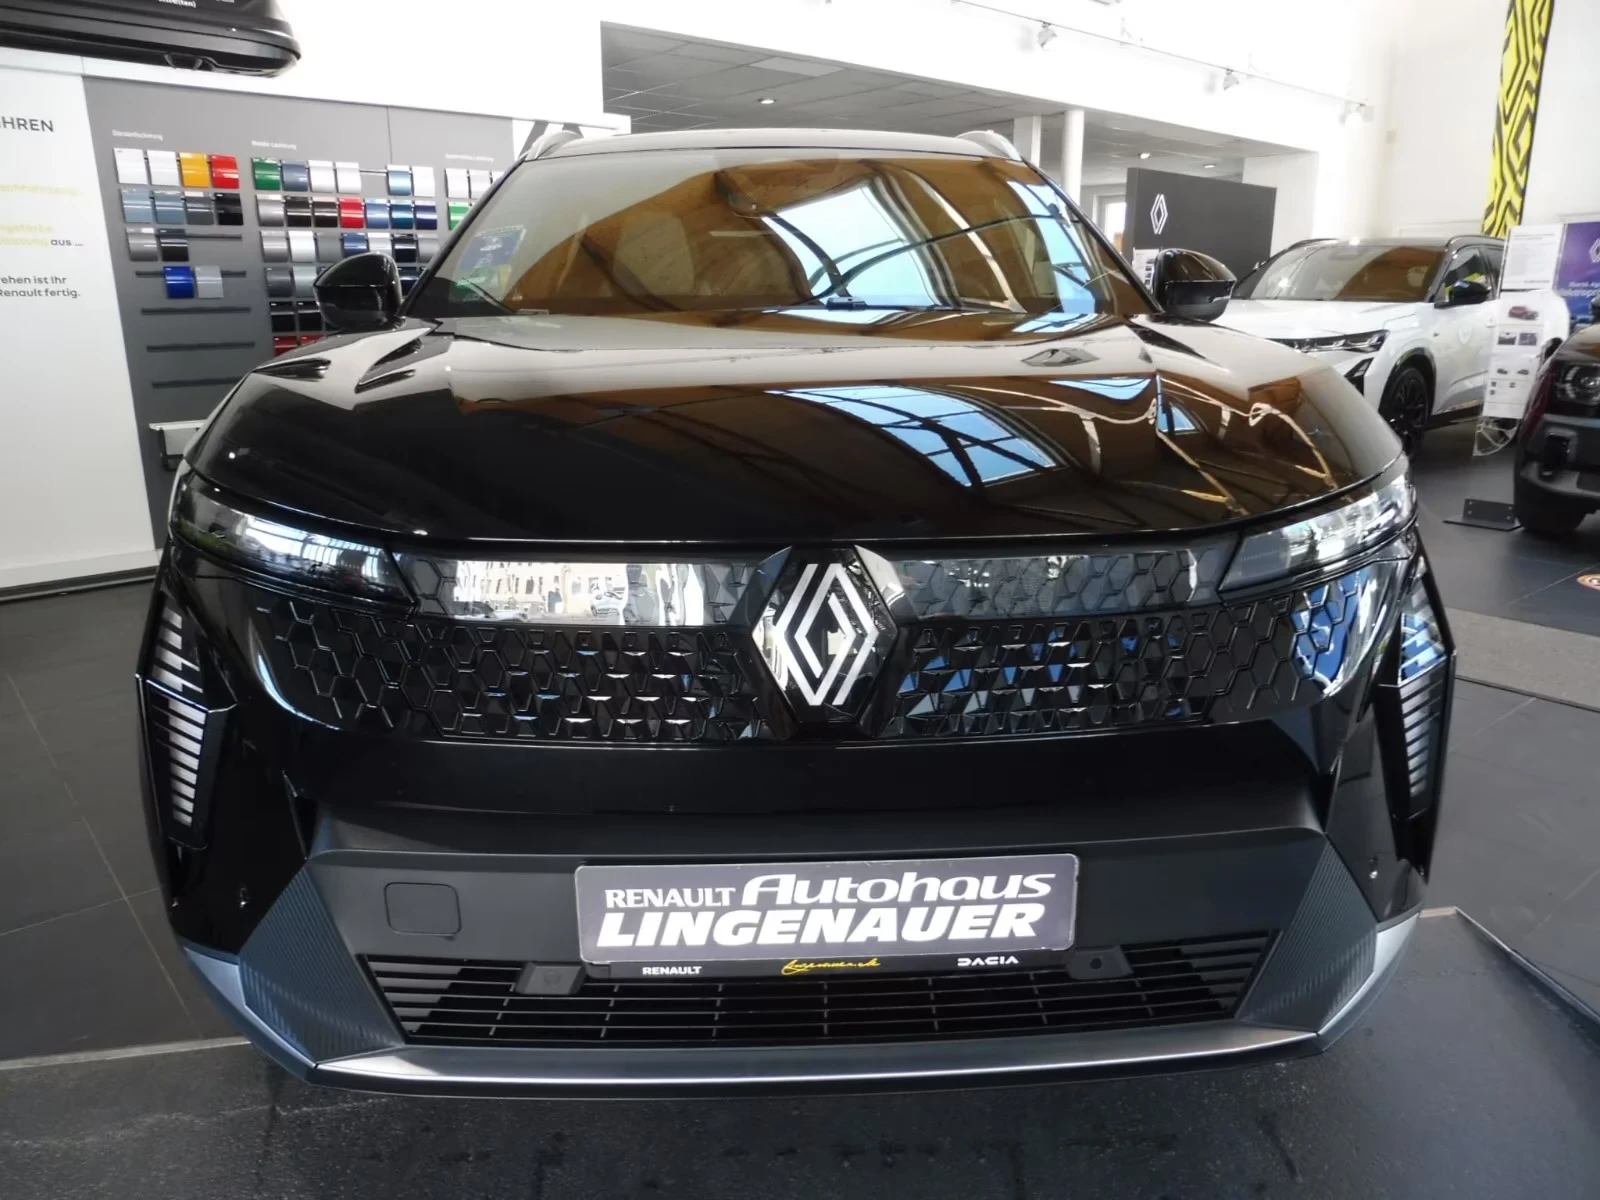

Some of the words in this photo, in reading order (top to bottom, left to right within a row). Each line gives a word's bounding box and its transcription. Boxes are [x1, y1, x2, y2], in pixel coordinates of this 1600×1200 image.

[0, 116, 54, 132] HREN
[50, 238, 72, 247] aus
[0, 276, 32, 285] ehen
[33, 276, 49, 285] ist
[50, 276, 67, 285] Ihr
[44, 289, 81, 301] fertig.
[605, 887, 736, 909] RENAULT
[741, 872, 1056, 905] Autohaus
[597, 903, 1045, 947] LINGENAUER
[957, 955, 1018, 967] DACIA
[642, 964, 701, 975] RENAULT
